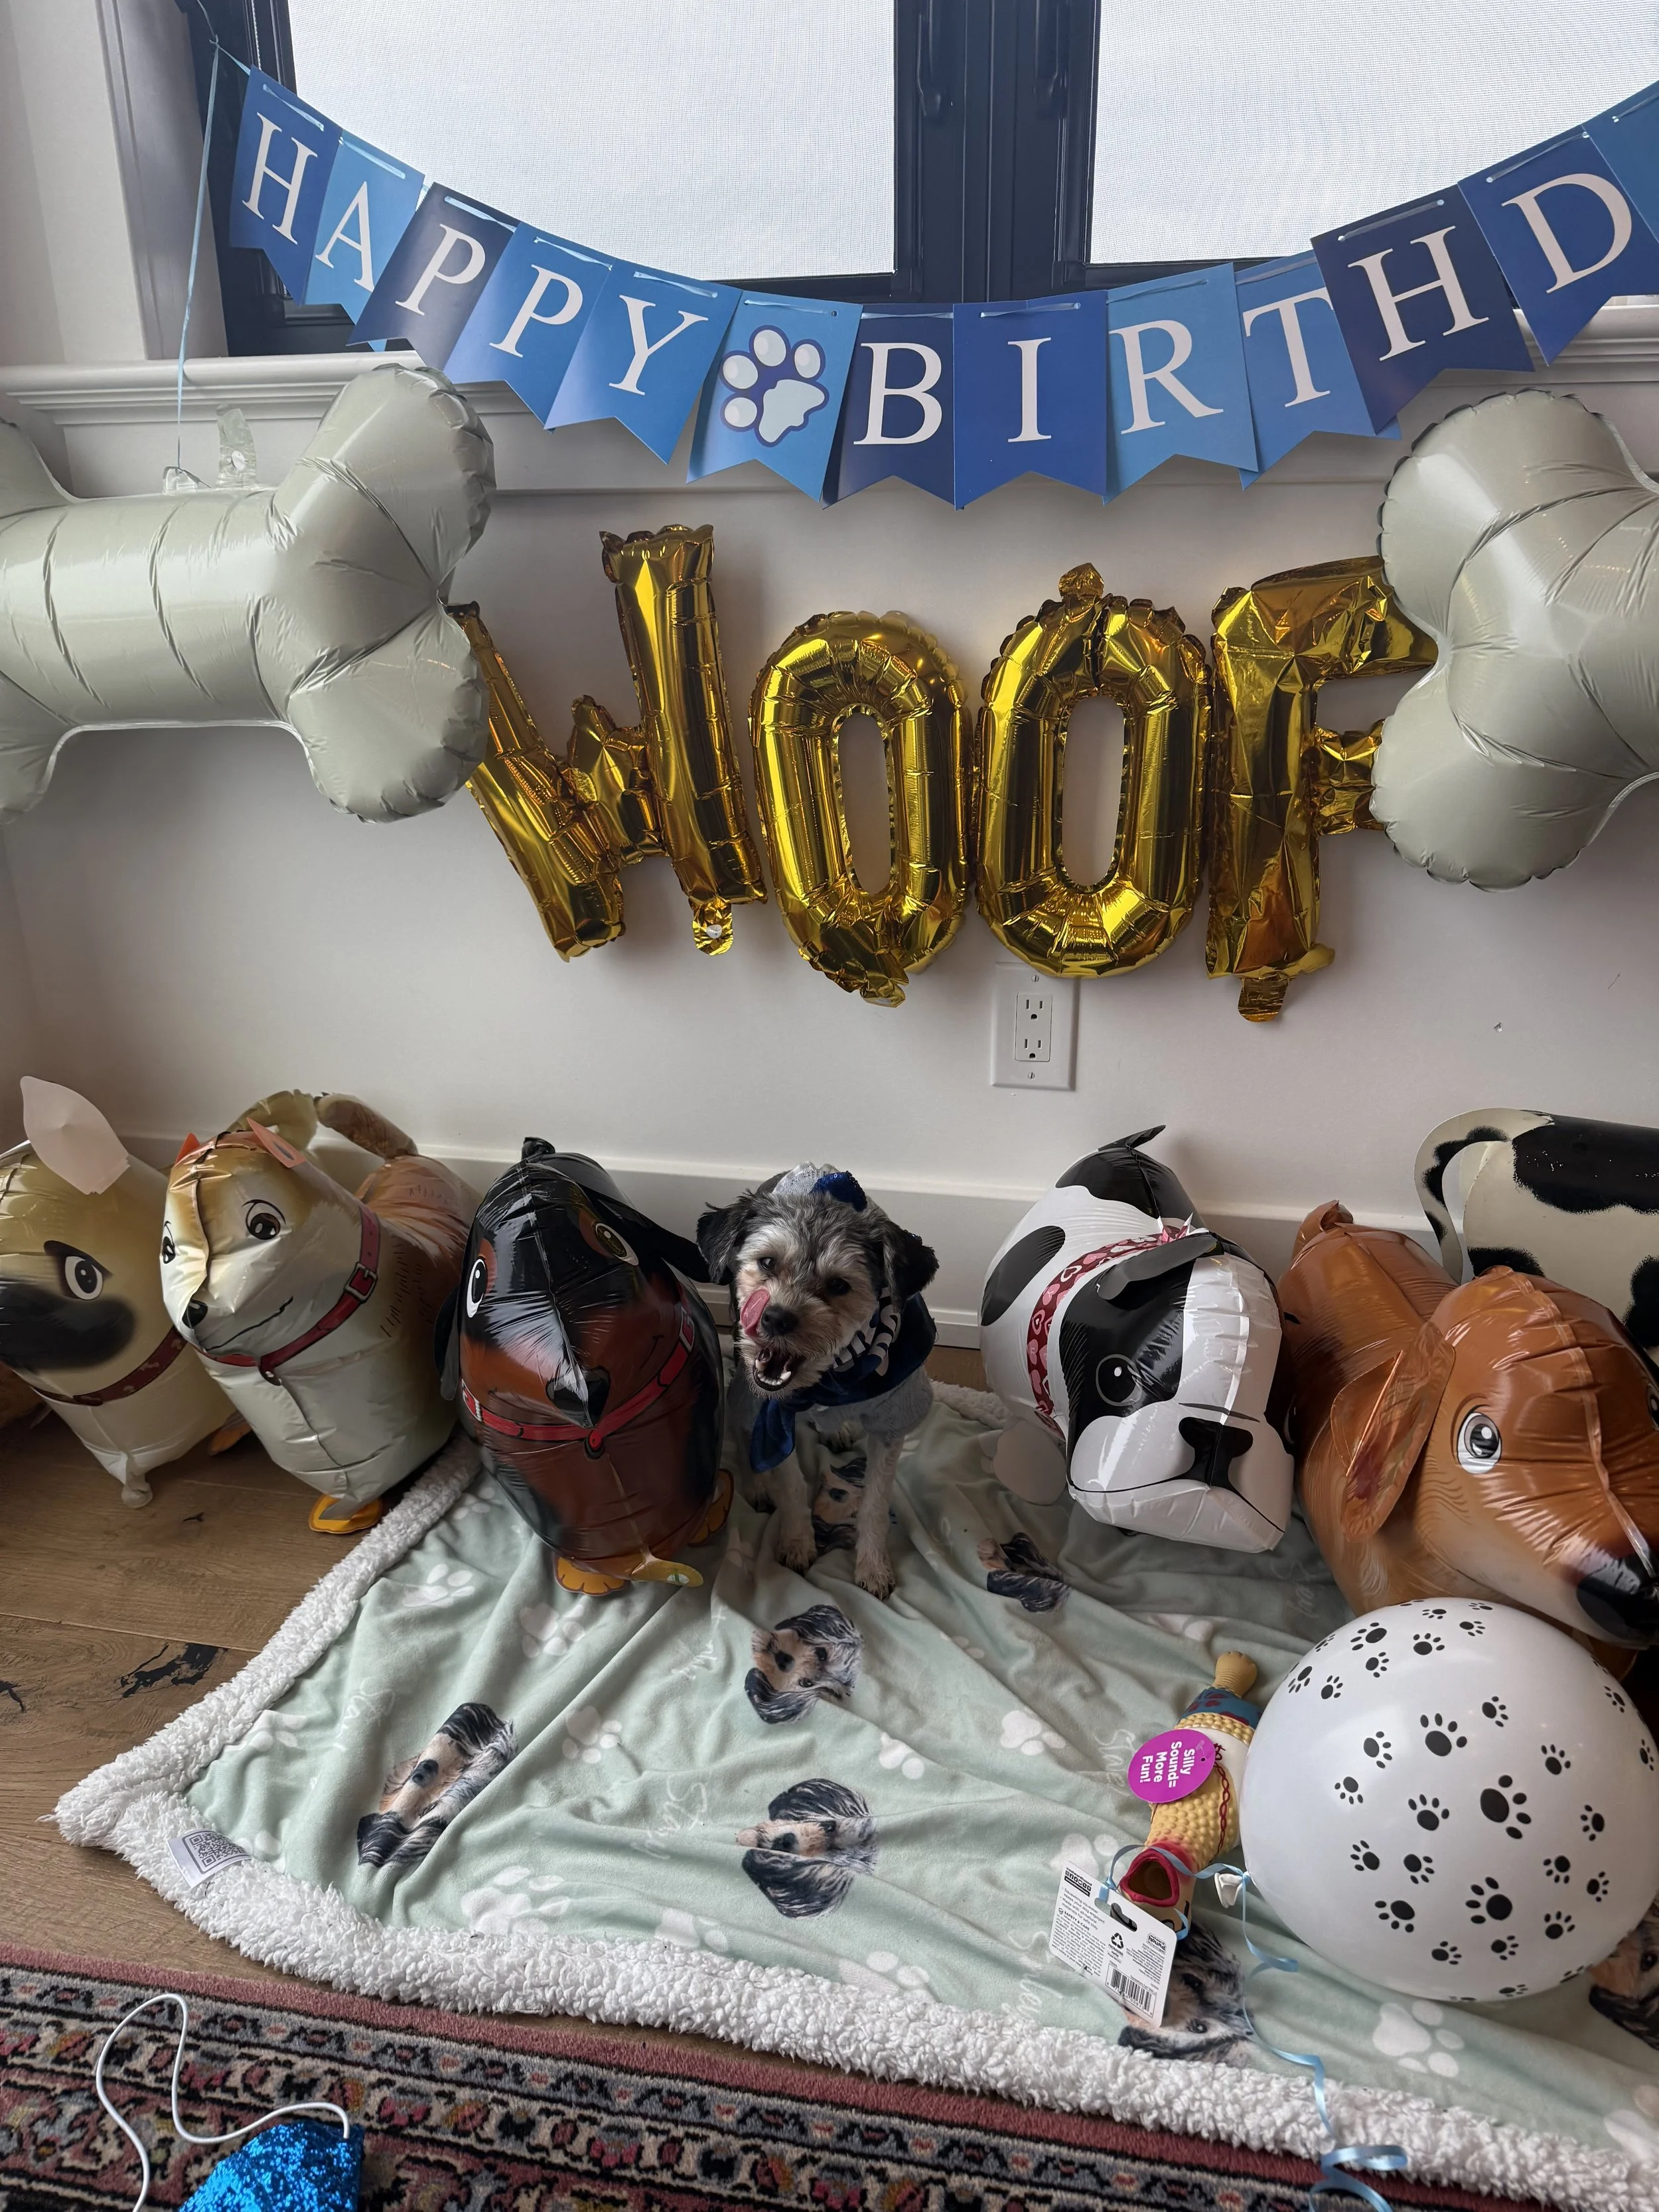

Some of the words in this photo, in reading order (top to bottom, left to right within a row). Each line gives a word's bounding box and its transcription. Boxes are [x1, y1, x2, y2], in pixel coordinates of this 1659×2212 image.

[242, 111, 708, 396] HAPPY
[447, 524, 1439, 1015] WOOF
[1140, 1755, 1153, 1783] Fun!
[1153, 1751, 1167, 1783] More
[1167, 1741, 1182, 1788] Sound=
[1180, 1748, 1195, 1775] Silly
